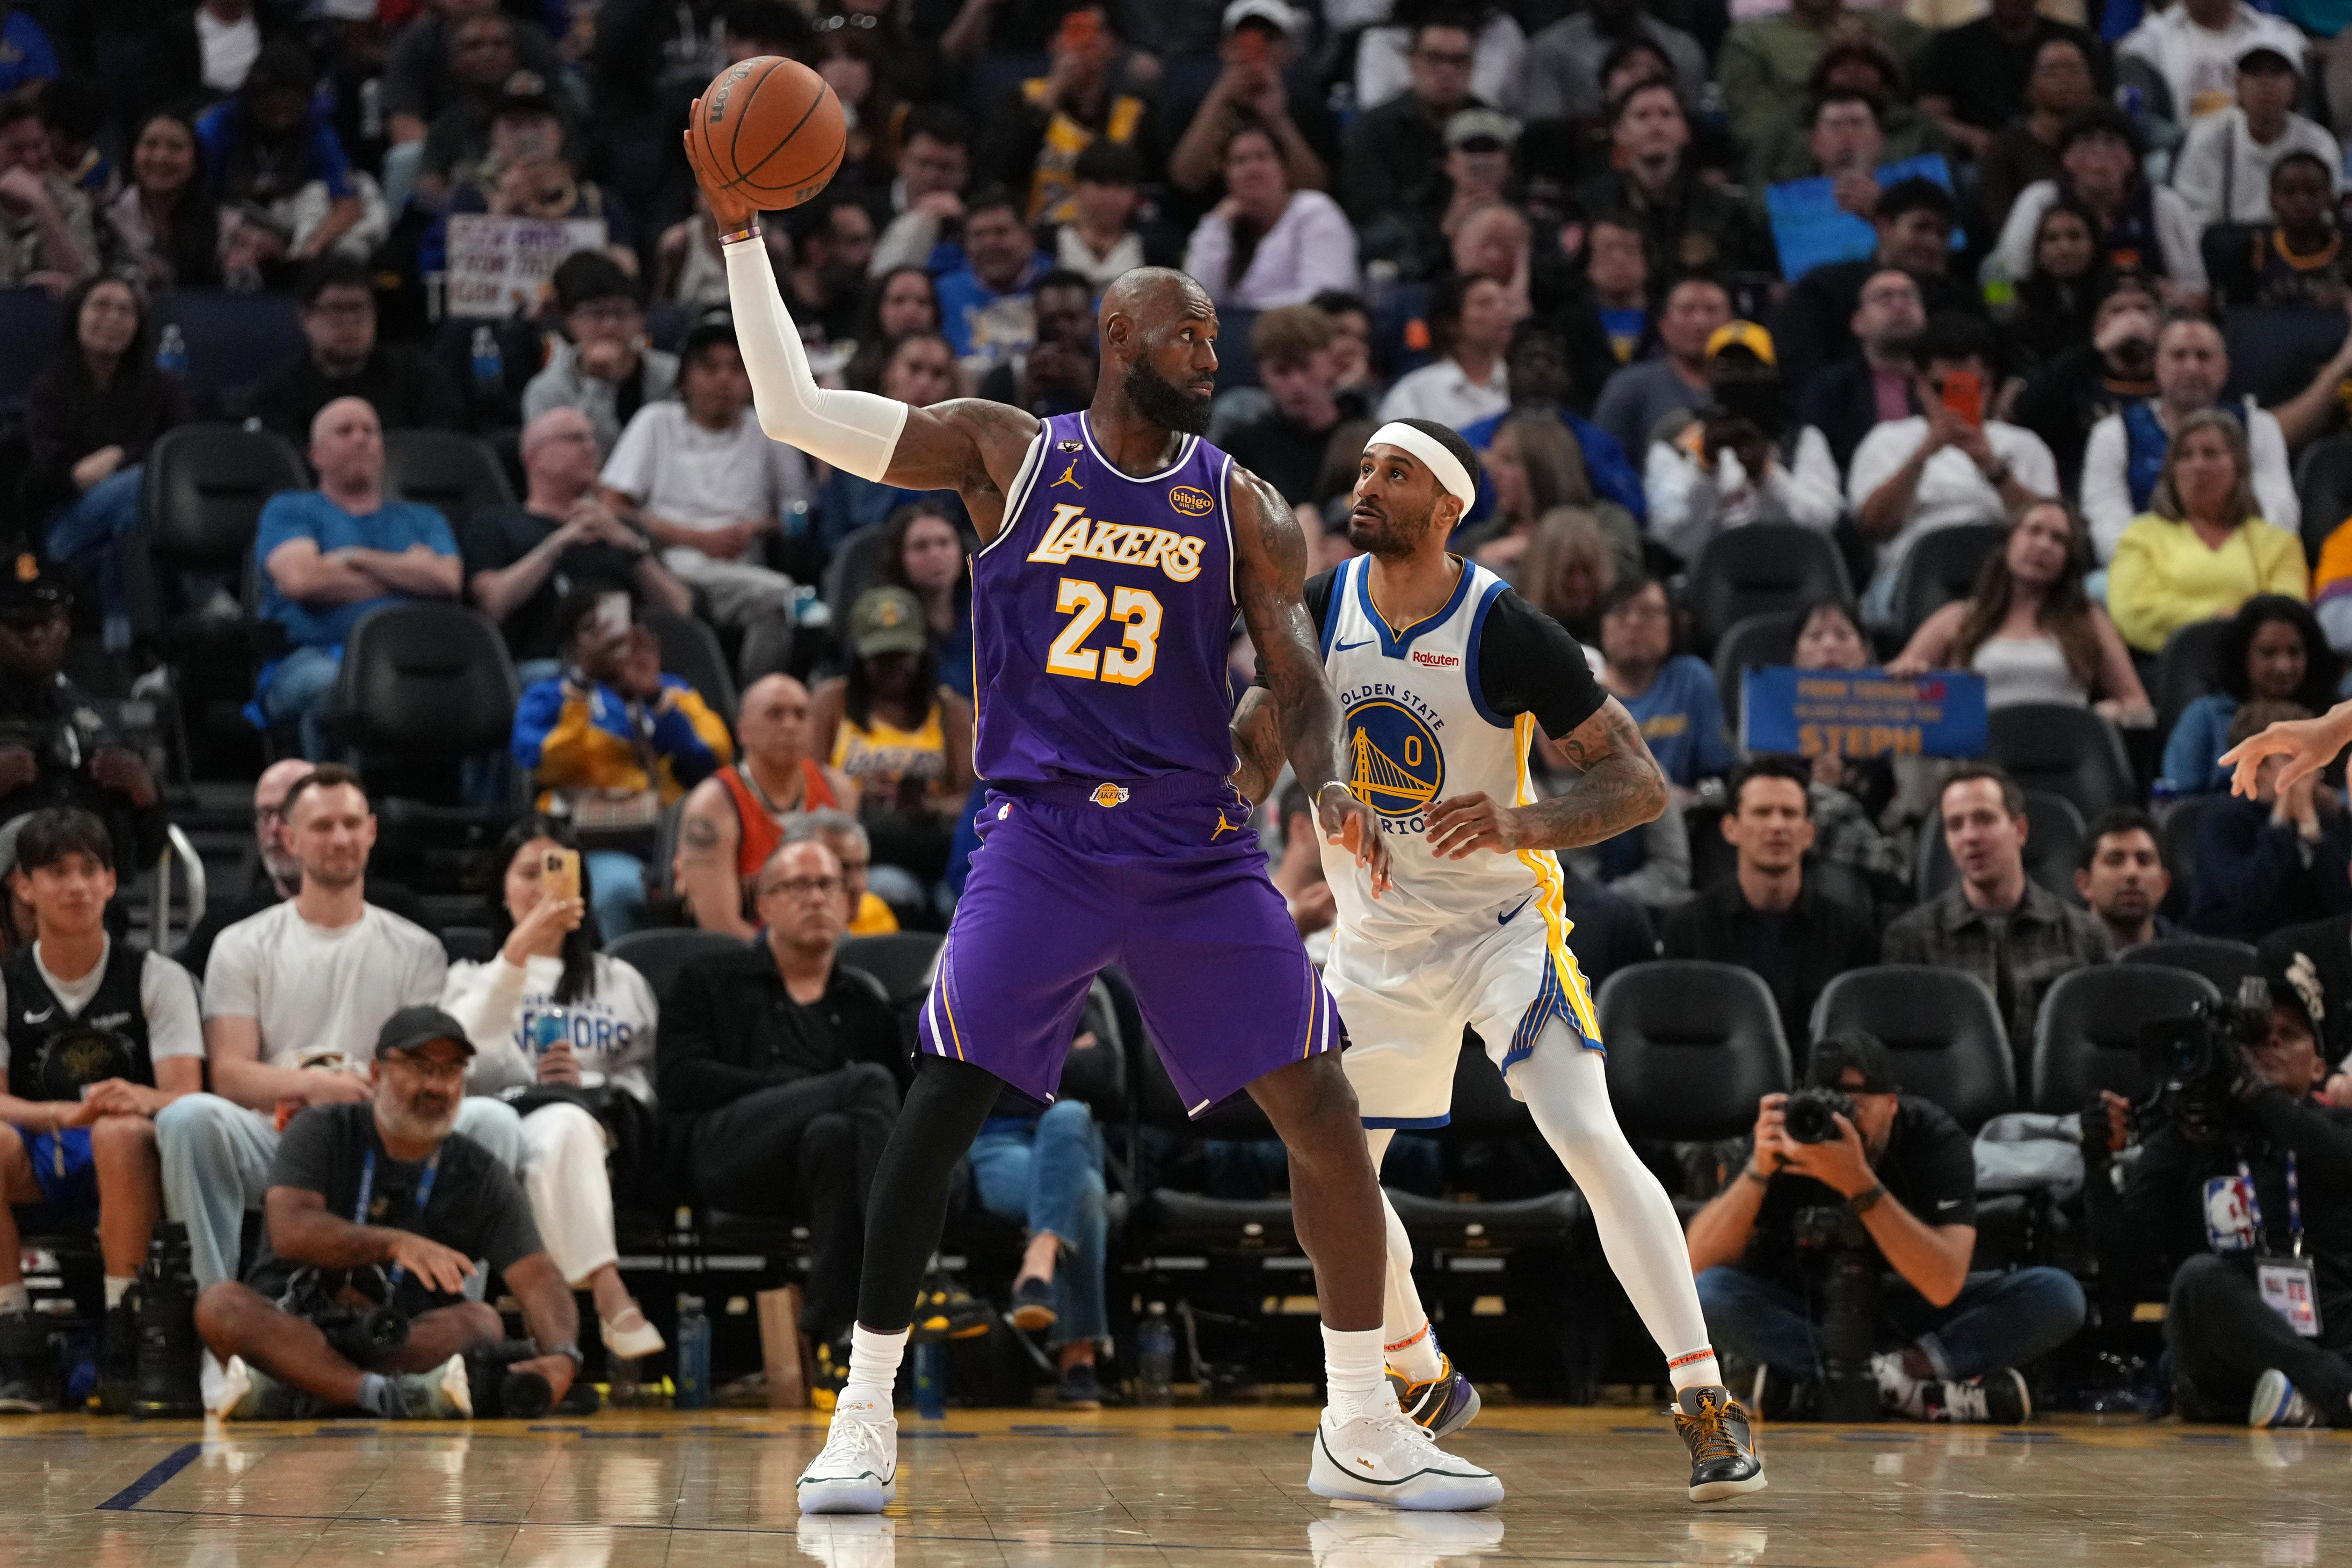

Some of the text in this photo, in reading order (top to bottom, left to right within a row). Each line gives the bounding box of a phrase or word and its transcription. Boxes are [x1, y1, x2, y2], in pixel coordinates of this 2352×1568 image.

[1173, 491, 1211, 509] bibigo
[1179, 502, 1195, 510] 비비고
[1026, 503, 1206, 583] LAKERS
[1046, 577, 1164, 686] 23
[1413, 651, 1460, 666] Rakuten
[1341, 684, 1444, 731] OLDEN STATE
[1405, 735, 1422, 767] 0
[1092, 789, 1127, 801] LAKERS
